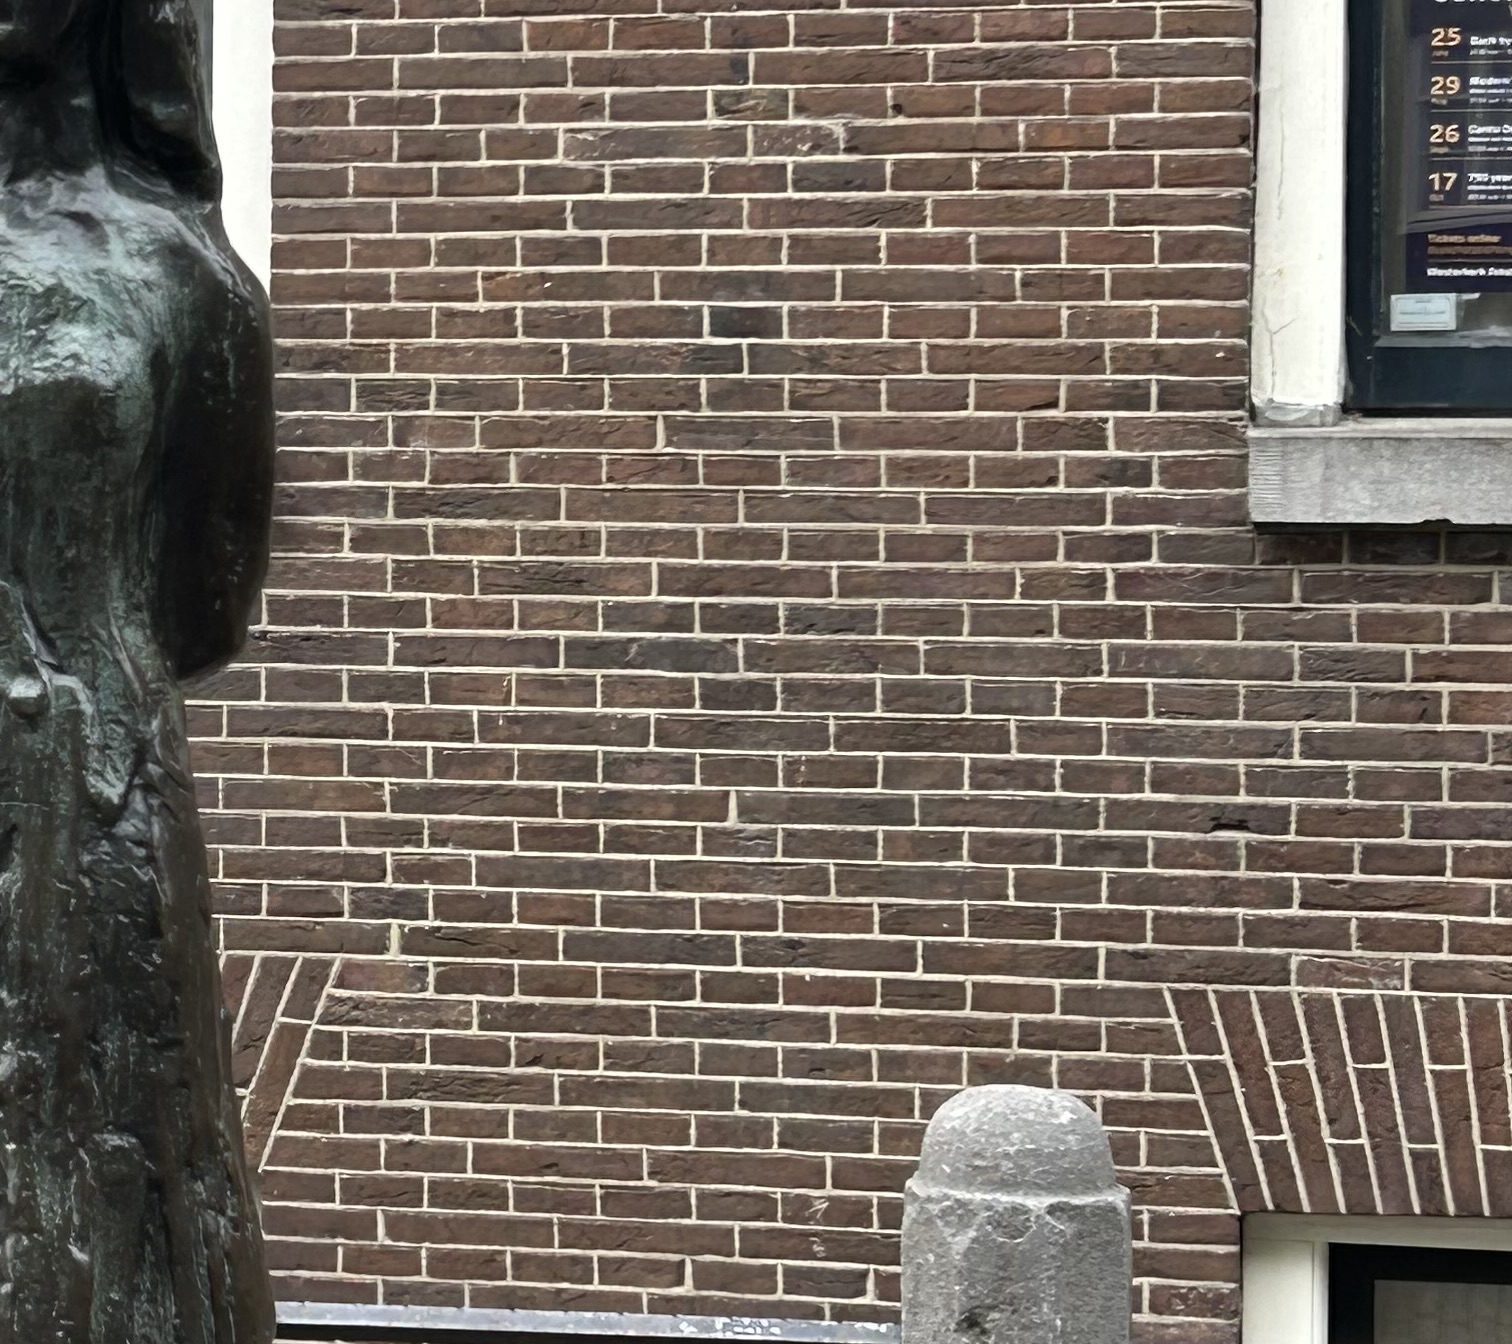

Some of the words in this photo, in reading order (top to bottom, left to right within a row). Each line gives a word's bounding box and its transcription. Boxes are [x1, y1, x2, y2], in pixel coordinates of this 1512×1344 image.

[1431, 27, 1462, 47] 25
[1430, 75, 1461, 95] 29
[1429, 124, 1460, 143] 26
[1428, 172, 1458, 191] 17
